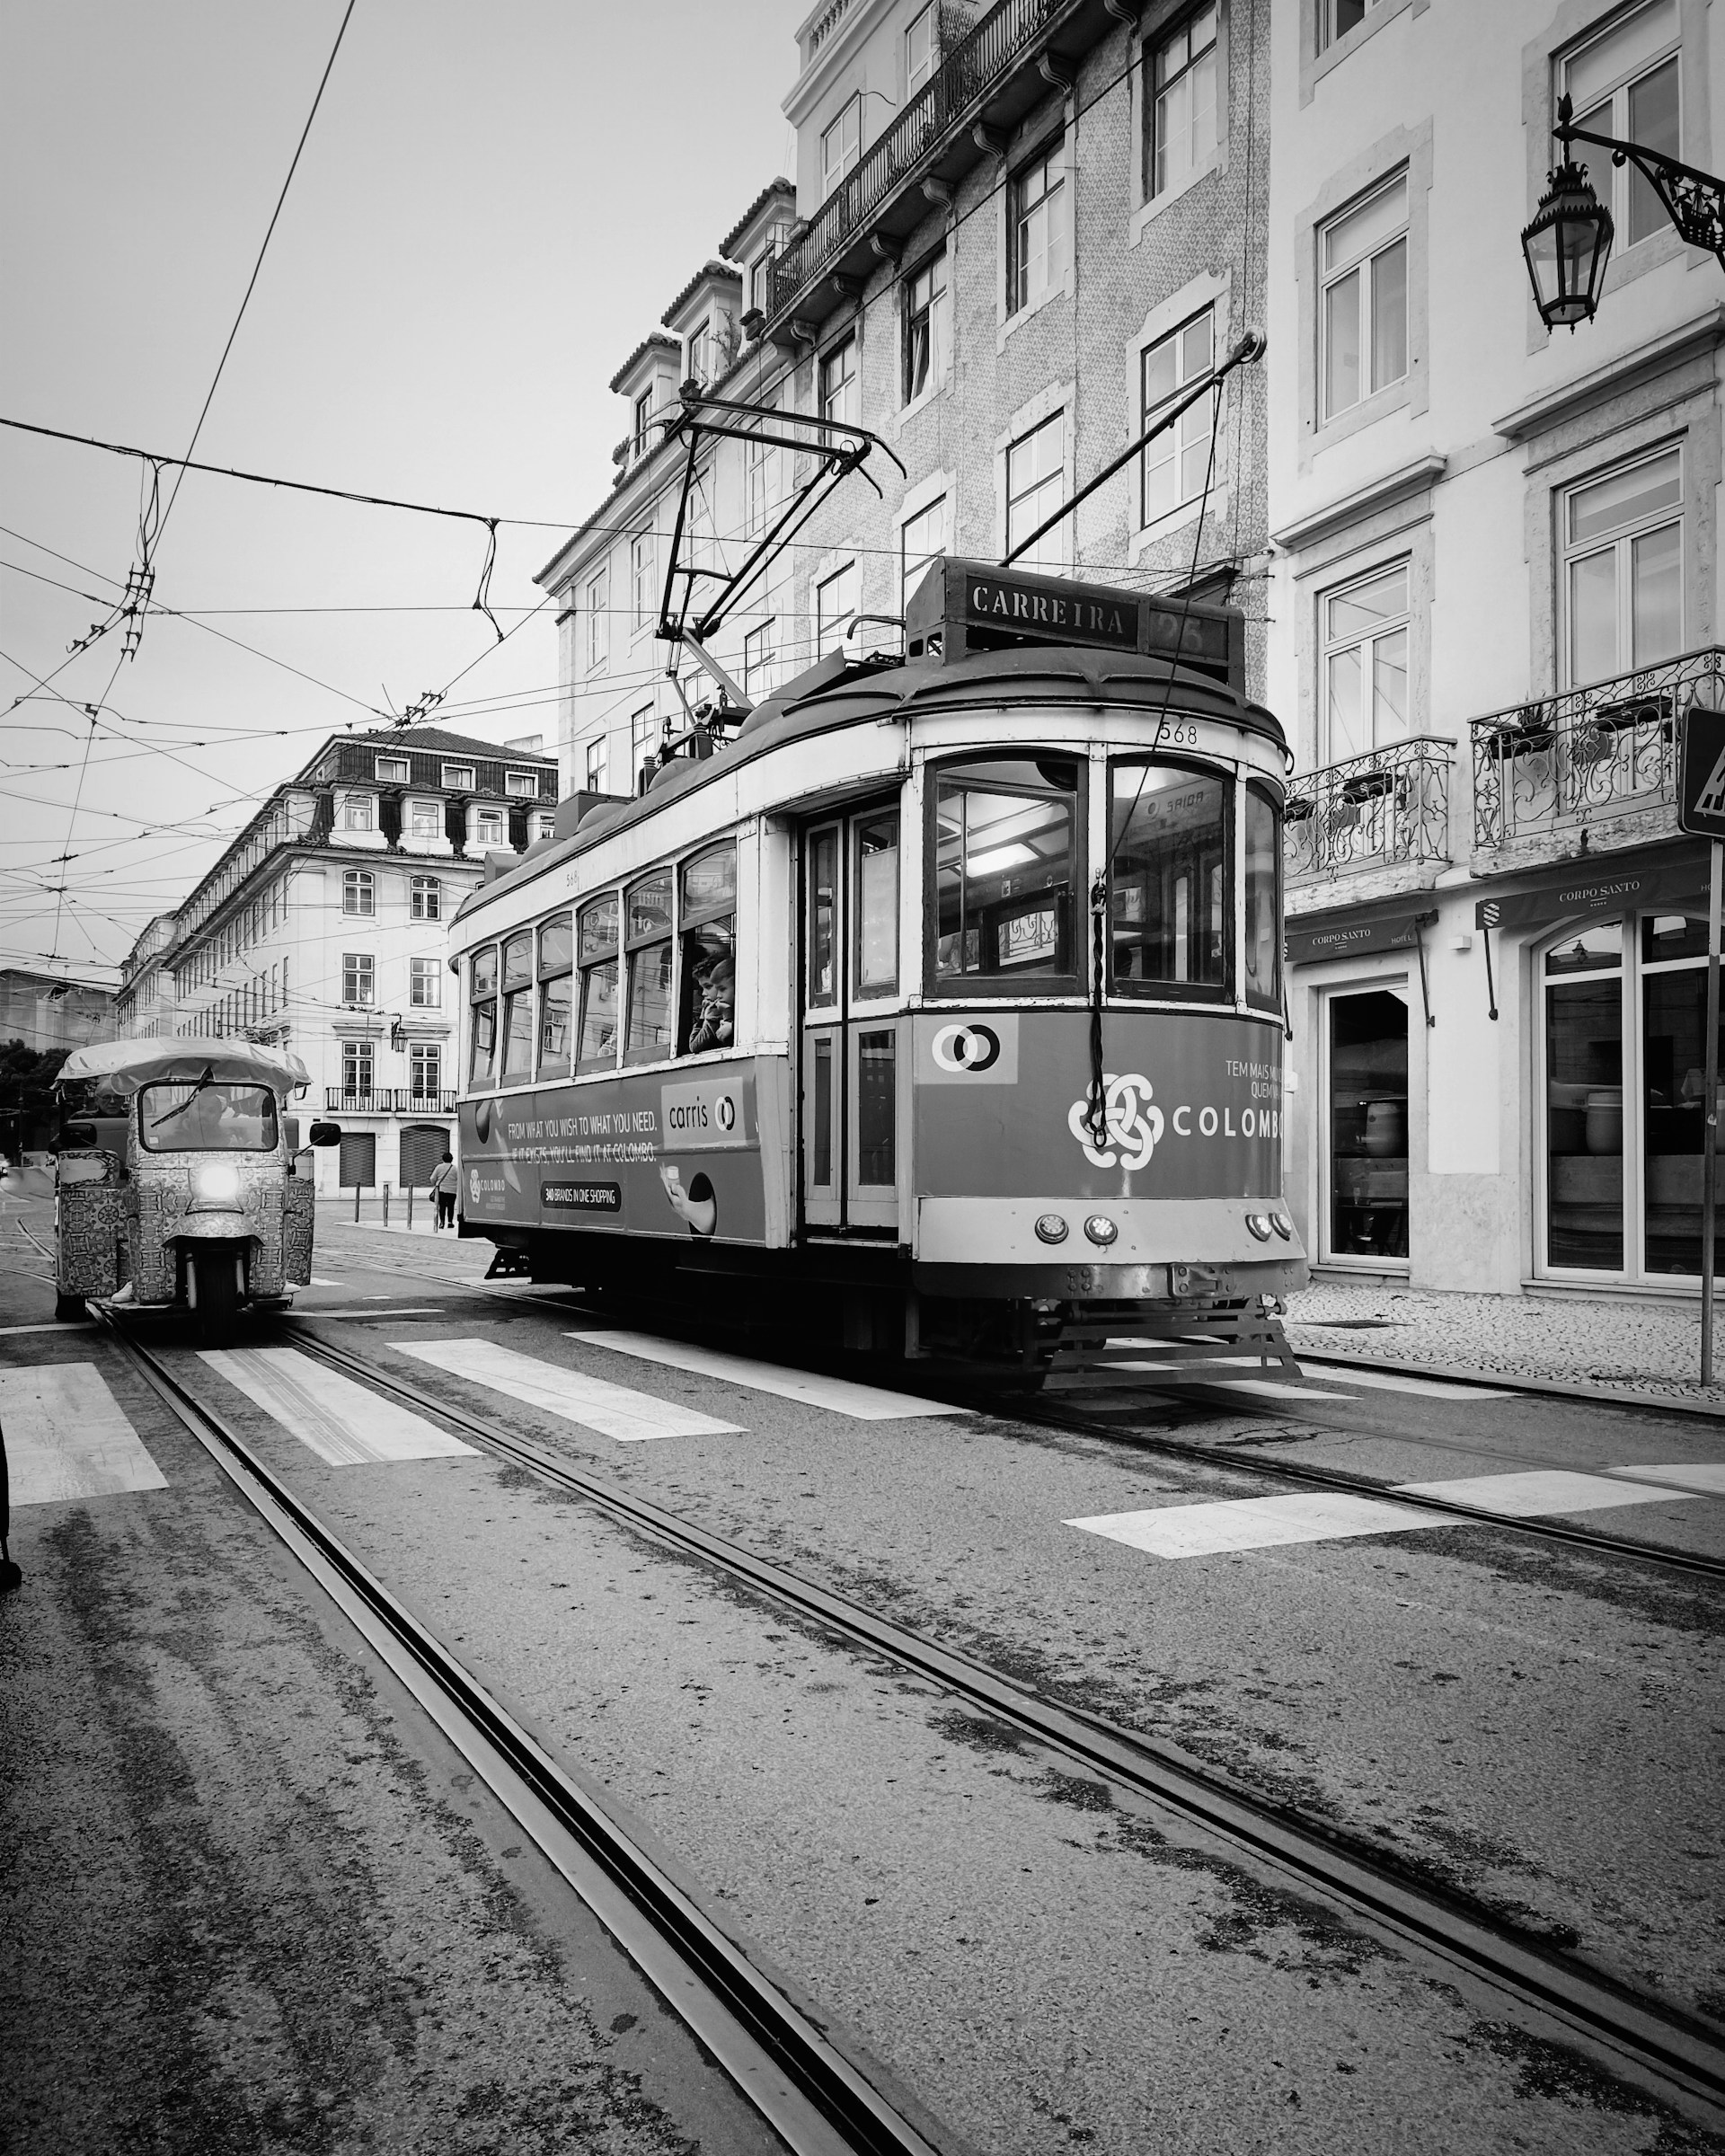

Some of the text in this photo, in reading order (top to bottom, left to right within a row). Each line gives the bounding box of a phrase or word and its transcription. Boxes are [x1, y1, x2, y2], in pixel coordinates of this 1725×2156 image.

[973, 586, 1123, 634] CARREIRA
[1160, 721, 1198, 745] 568
[1167, 791, 1204, 813] SAIDA
[1559, 880, 1641, 903] CORPO SANTO
[1312, 928, 1412, 946] CORPO SANTO HOTEL
[1225, 1060, 1248, 1077] TEM
[1250, 1063, 1269, 1080] MAIS
[1251, 1081, 1272, 1099] QUEM
[669, 1096, 708, 1129] carris
[508, 1110, 658, 1140] FROM WHAT YOU WISH TO WHAT YOU NEED.
[518, 1147, 525, 1163] IT
[575, 1144, 592, 1163] FIND
[593, 1144, 601, 1163] IT
[603, 1143, 612, 1163] AT
[613, 1141, 657, 1163] COLOMBO.
[480, 1179, 505, 1191] COLOMBO
[554, 1188, 572, 1203] BRANDS
[573, 1188, 579, 1203] IN
[579, 1188, 589, 1204] ONE
[590, 1188, 615, 1205] SHOPPING
